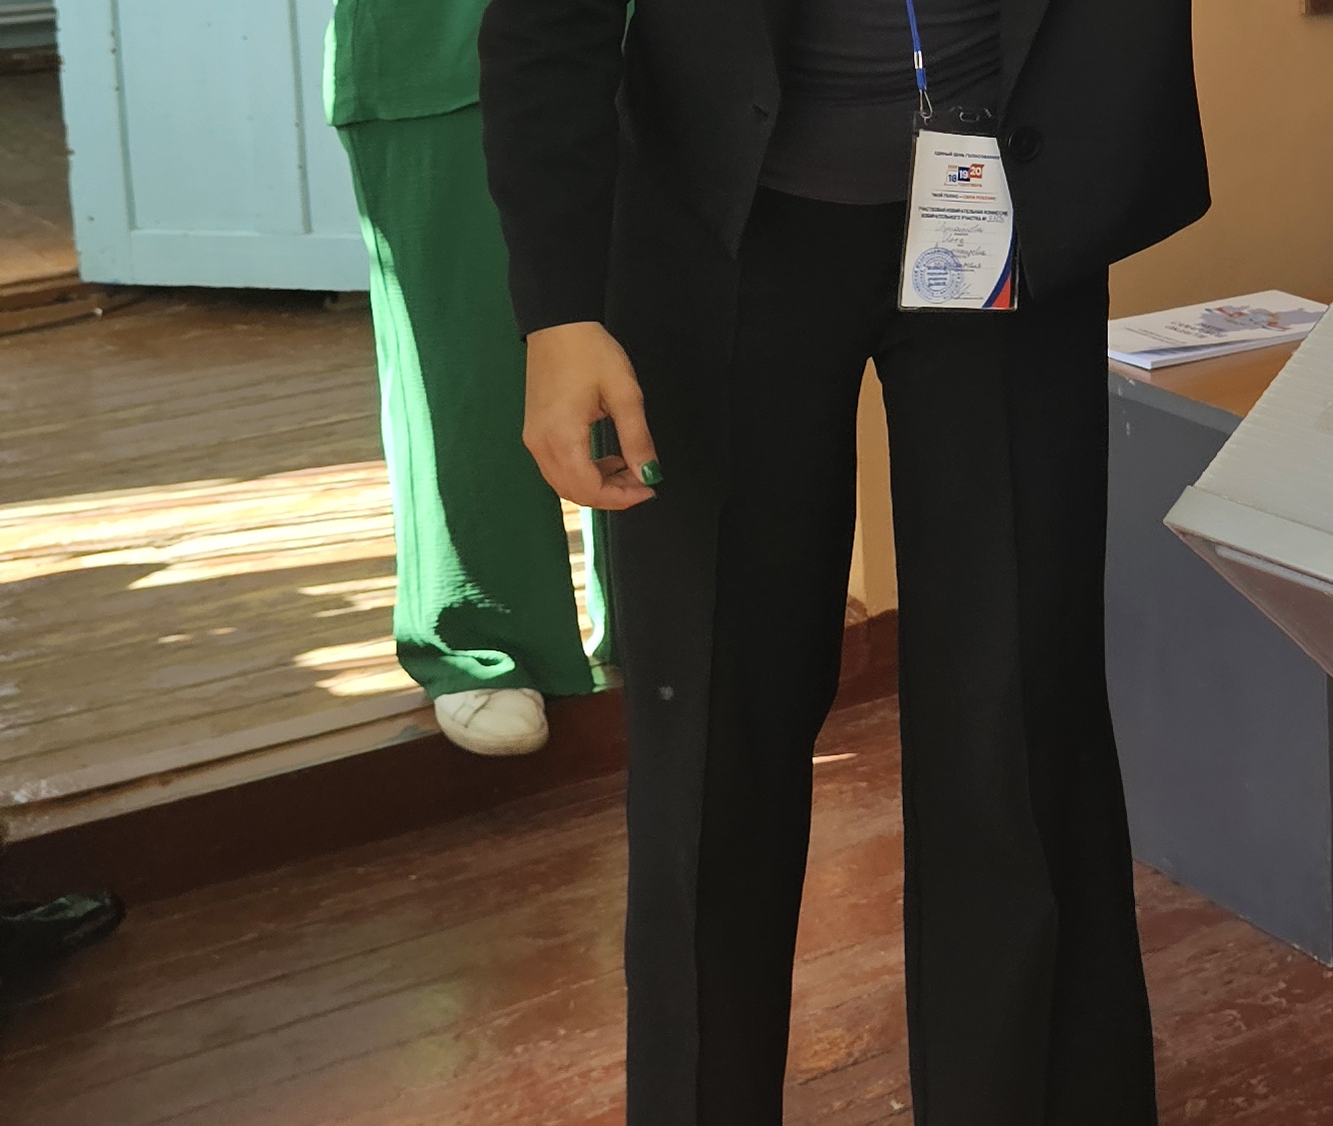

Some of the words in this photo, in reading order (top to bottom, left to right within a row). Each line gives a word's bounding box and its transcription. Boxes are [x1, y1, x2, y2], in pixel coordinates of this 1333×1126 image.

[948, 174, 957, 182] 18
[959, 170, 968, 179] 19
[970, 167, 981, 176] 20
